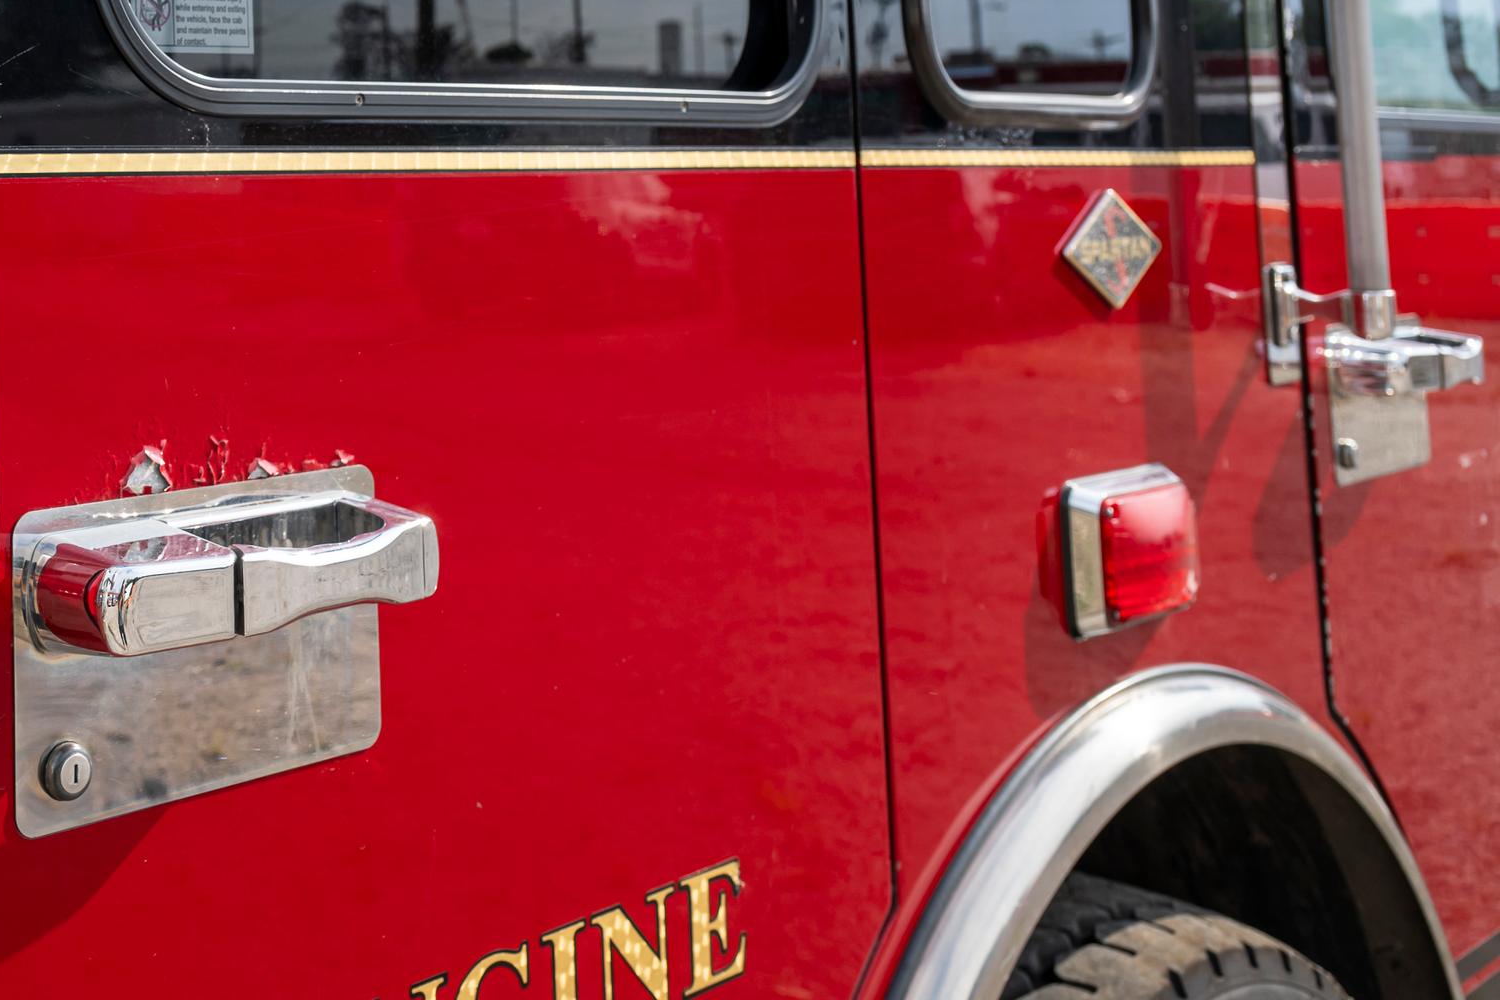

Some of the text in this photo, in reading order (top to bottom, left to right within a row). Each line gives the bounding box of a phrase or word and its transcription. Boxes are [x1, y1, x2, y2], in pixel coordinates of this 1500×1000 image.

[192, 5, 214, 14] entering
[229, 28, 246, 36] points
[411, 857, 747, 1000] INE
